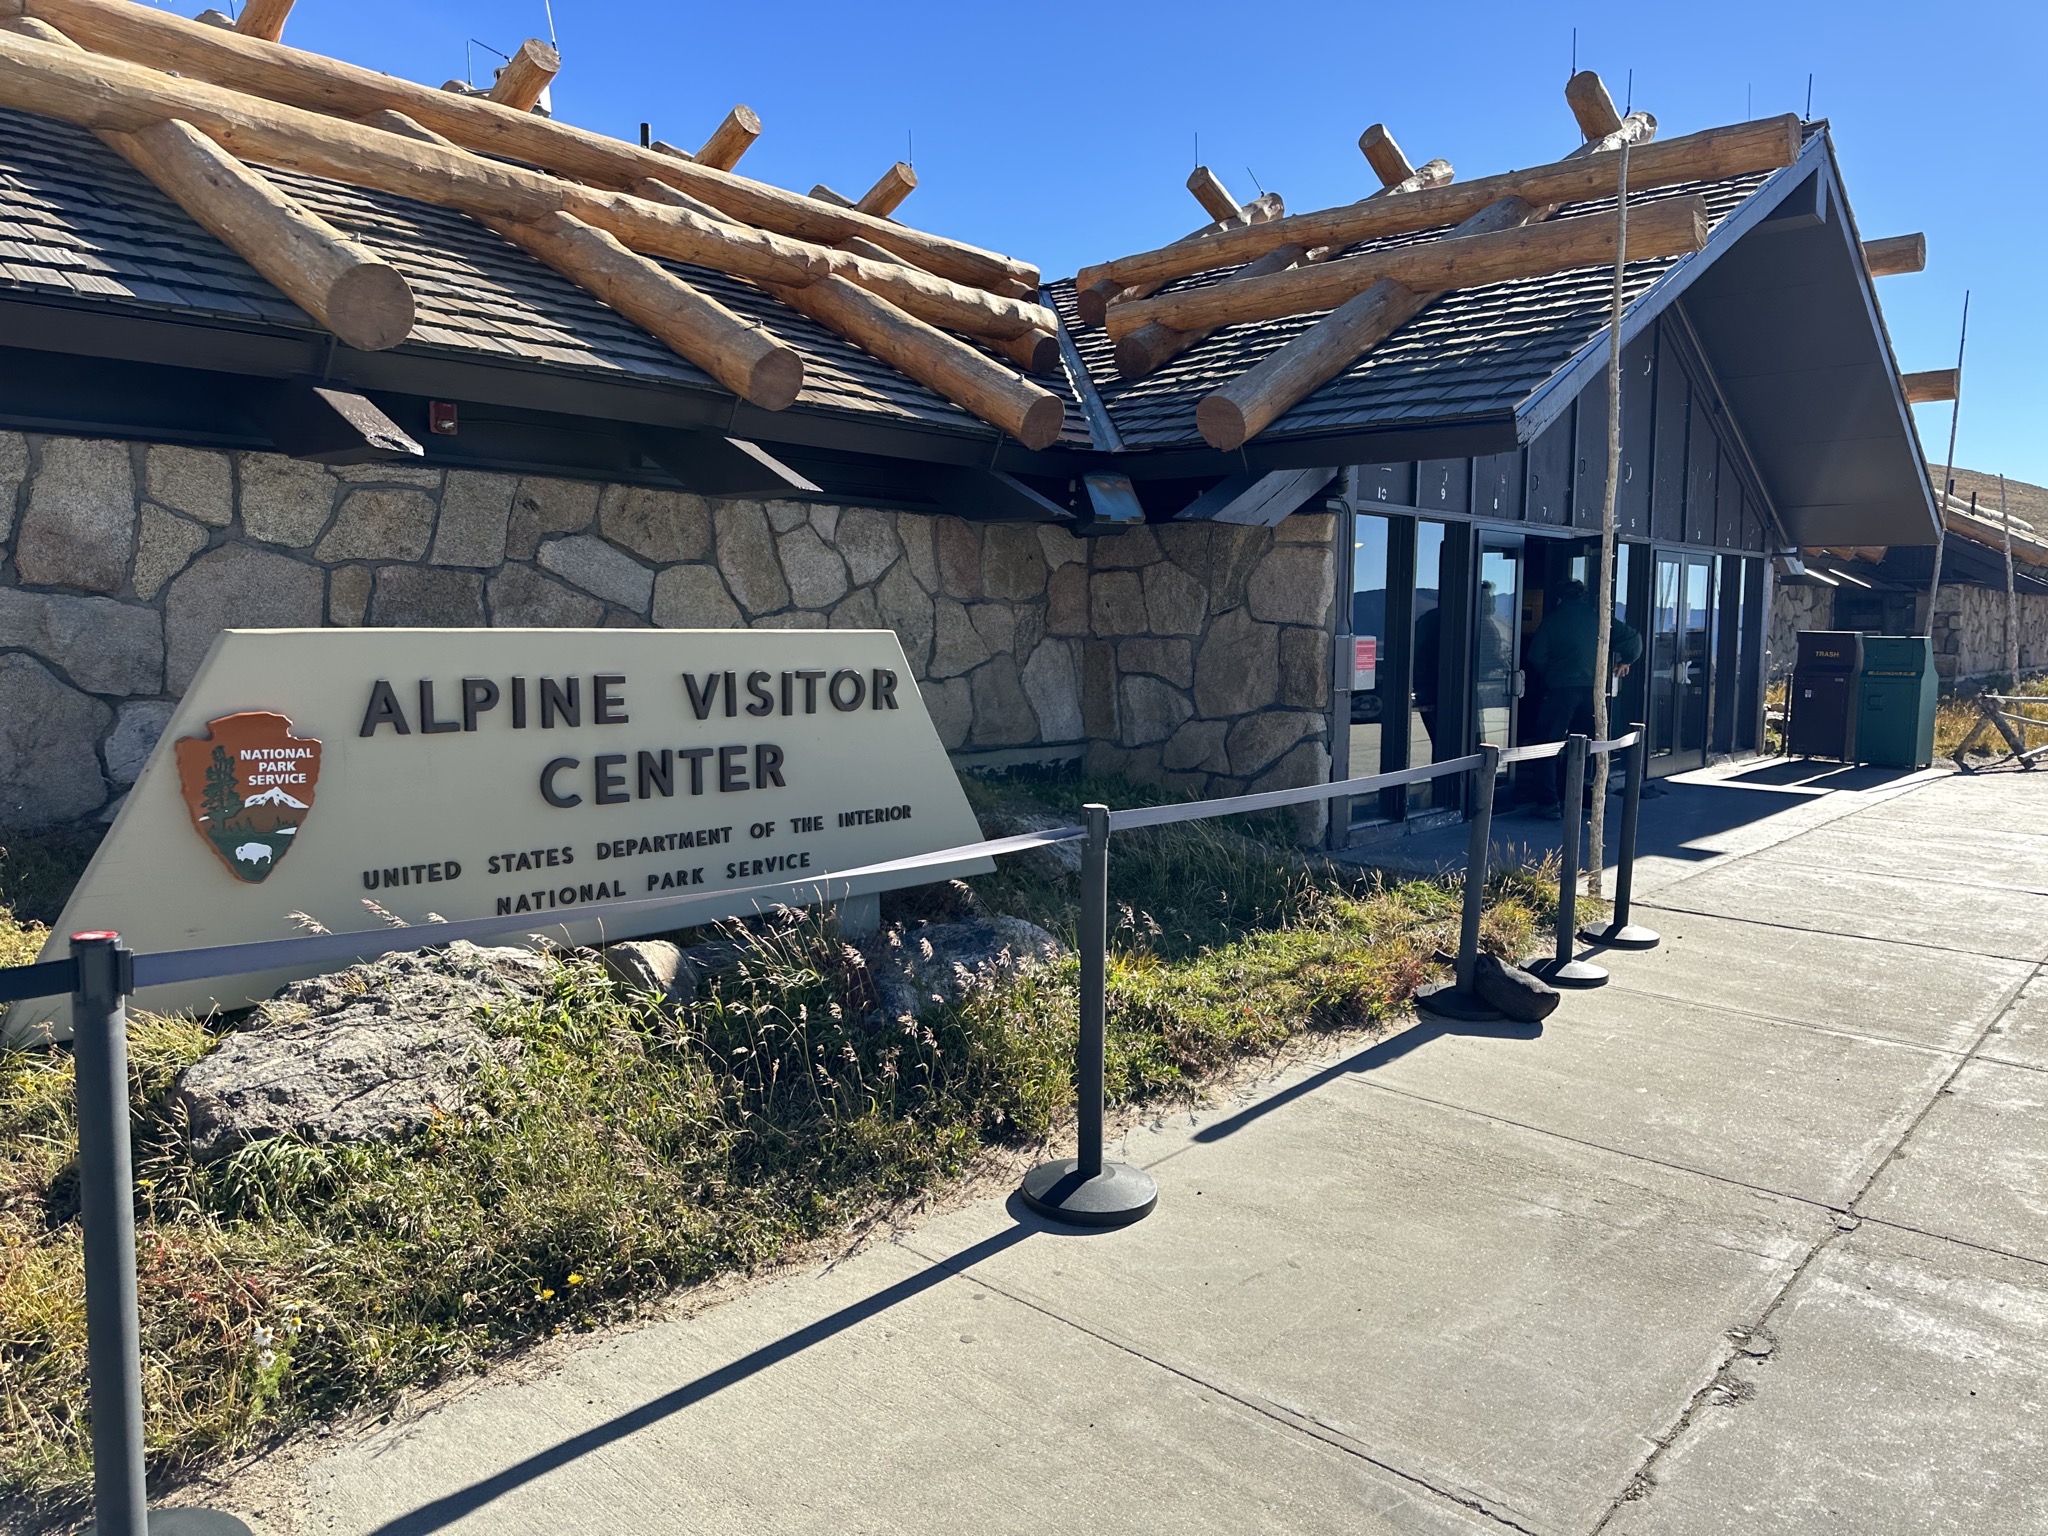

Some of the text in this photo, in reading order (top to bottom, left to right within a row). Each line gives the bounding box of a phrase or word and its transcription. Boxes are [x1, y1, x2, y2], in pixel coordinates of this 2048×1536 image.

[1440, 488, 1446, 500] 9
[1493, 497, 1499, 510] 8
[1631, 518, 1636, 528] 5
[1815, 650, 1839, 658] TRASH
[359, 668, 900, 738] ALPINE VISITOR
[240, 747, 314, 760] NATIONAL
[258, 761, 296, 772] PARK
[248, 773, 306, 786] SERVICE
[539, 743, 787, 809] CENTER
[363, 804, 912, 890] UNITED STATES DEPARTMENT OF THE INTERIOR
[496, 852, 810, 916] NATIONAL PARK SERVICE
